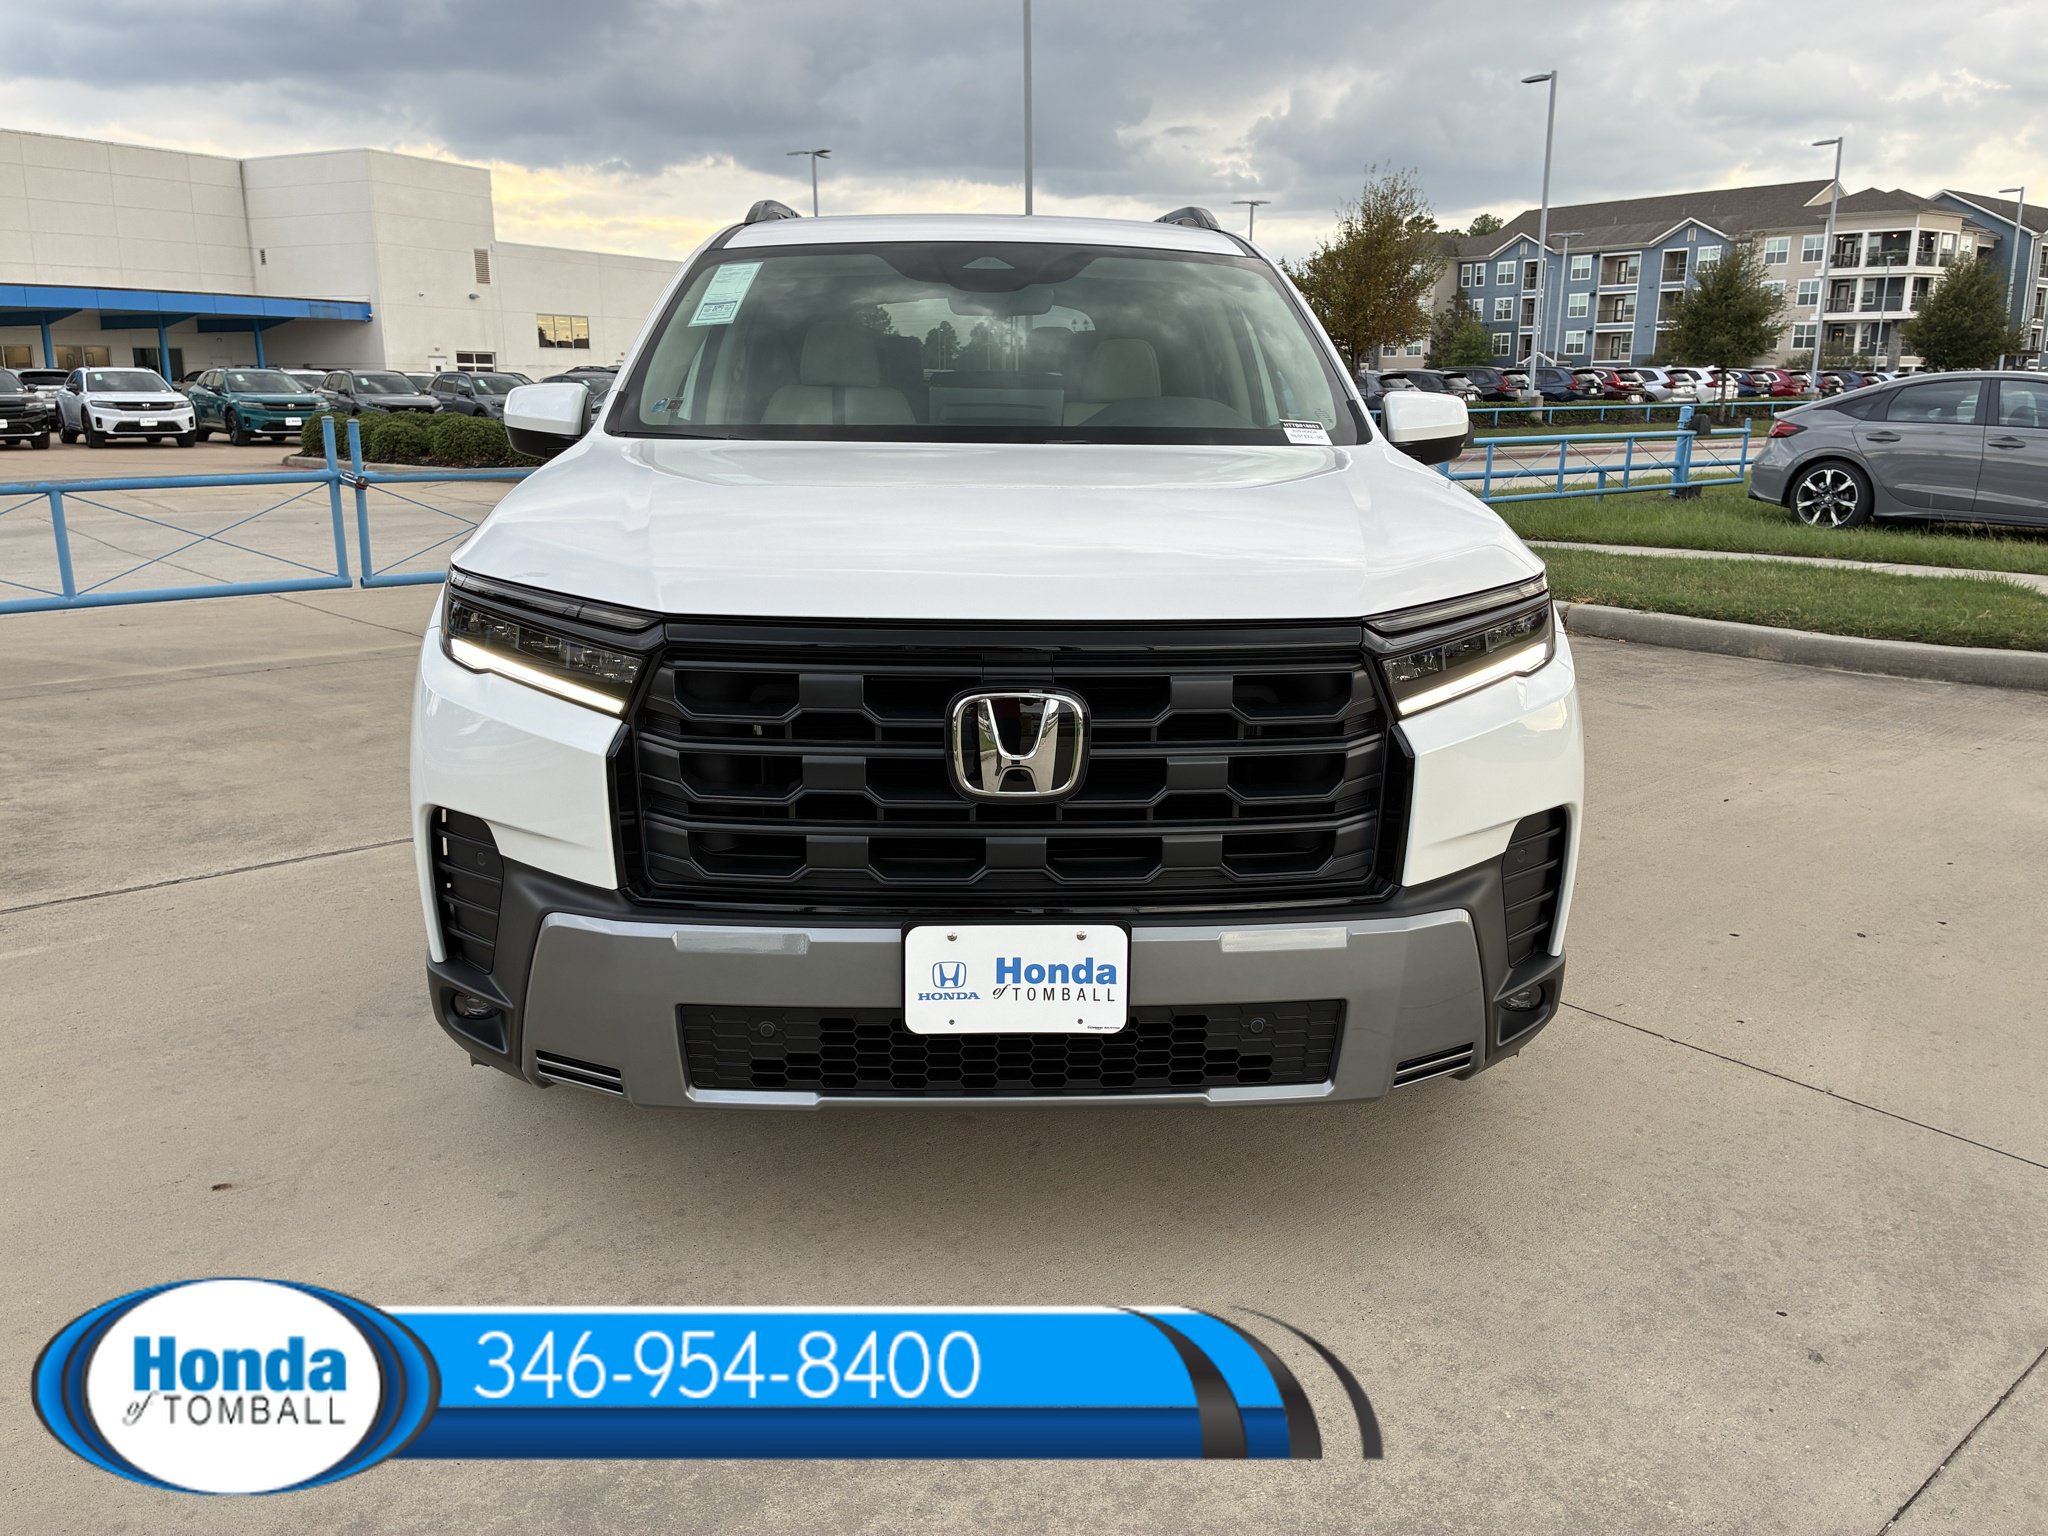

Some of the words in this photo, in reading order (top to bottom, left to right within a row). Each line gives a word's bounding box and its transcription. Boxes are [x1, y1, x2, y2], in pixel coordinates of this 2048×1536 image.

[995, 957, 1117, 985] Honda
[917, 992, 981, 1001] HONDA
[992, 984, 1011, 1000] of
[1012, 987, 1116, 1002] TOMBALL
